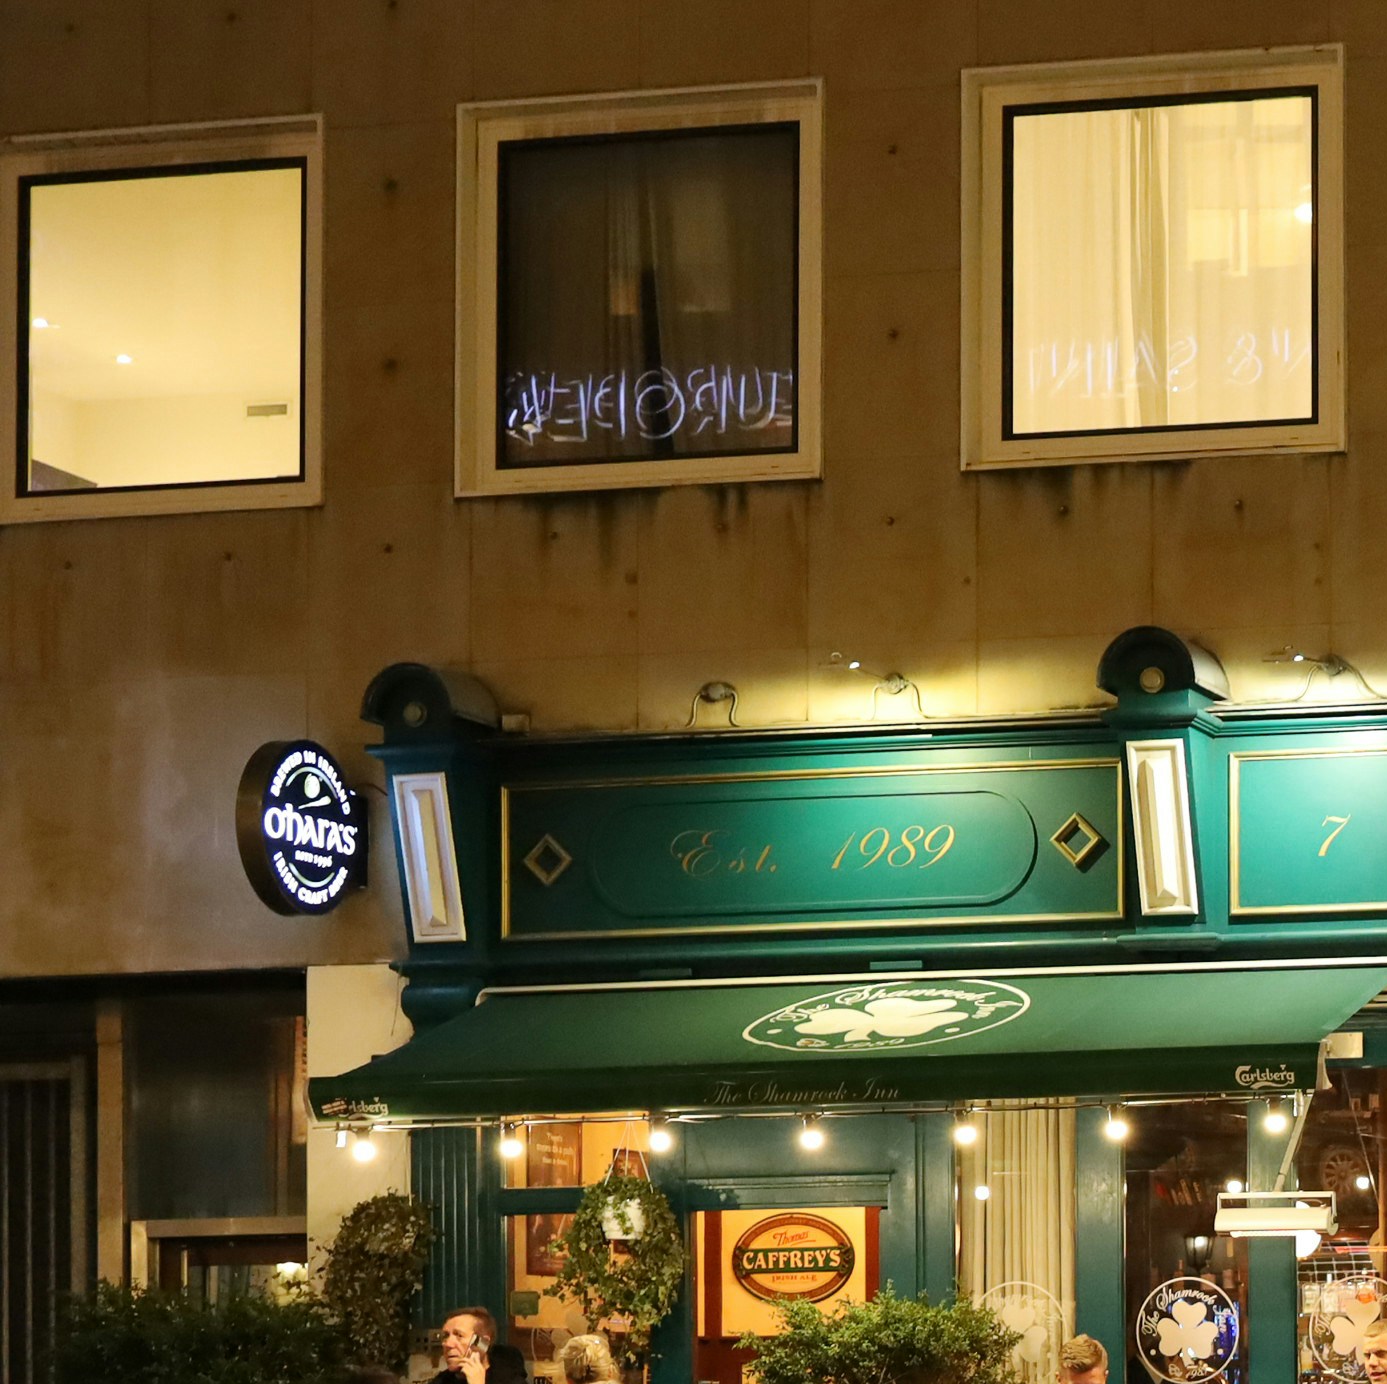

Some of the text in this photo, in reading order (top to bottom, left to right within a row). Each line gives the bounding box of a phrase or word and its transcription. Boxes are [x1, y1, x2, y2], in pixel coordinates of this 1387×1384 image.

[669, 824, 955, 877] Est. 1989
[1318, 813, 1351, 856] 7
[703, 1075, 900, 1104] The Shamrock Inn
[1235, 1064, 1295, 1089] Carlsberg
[742, 1249, 841, 1269] CAFFREY'S
[1141, 1310, 1160, 1336] The
[1156, 1286, 1218, 1312] Shamrock
